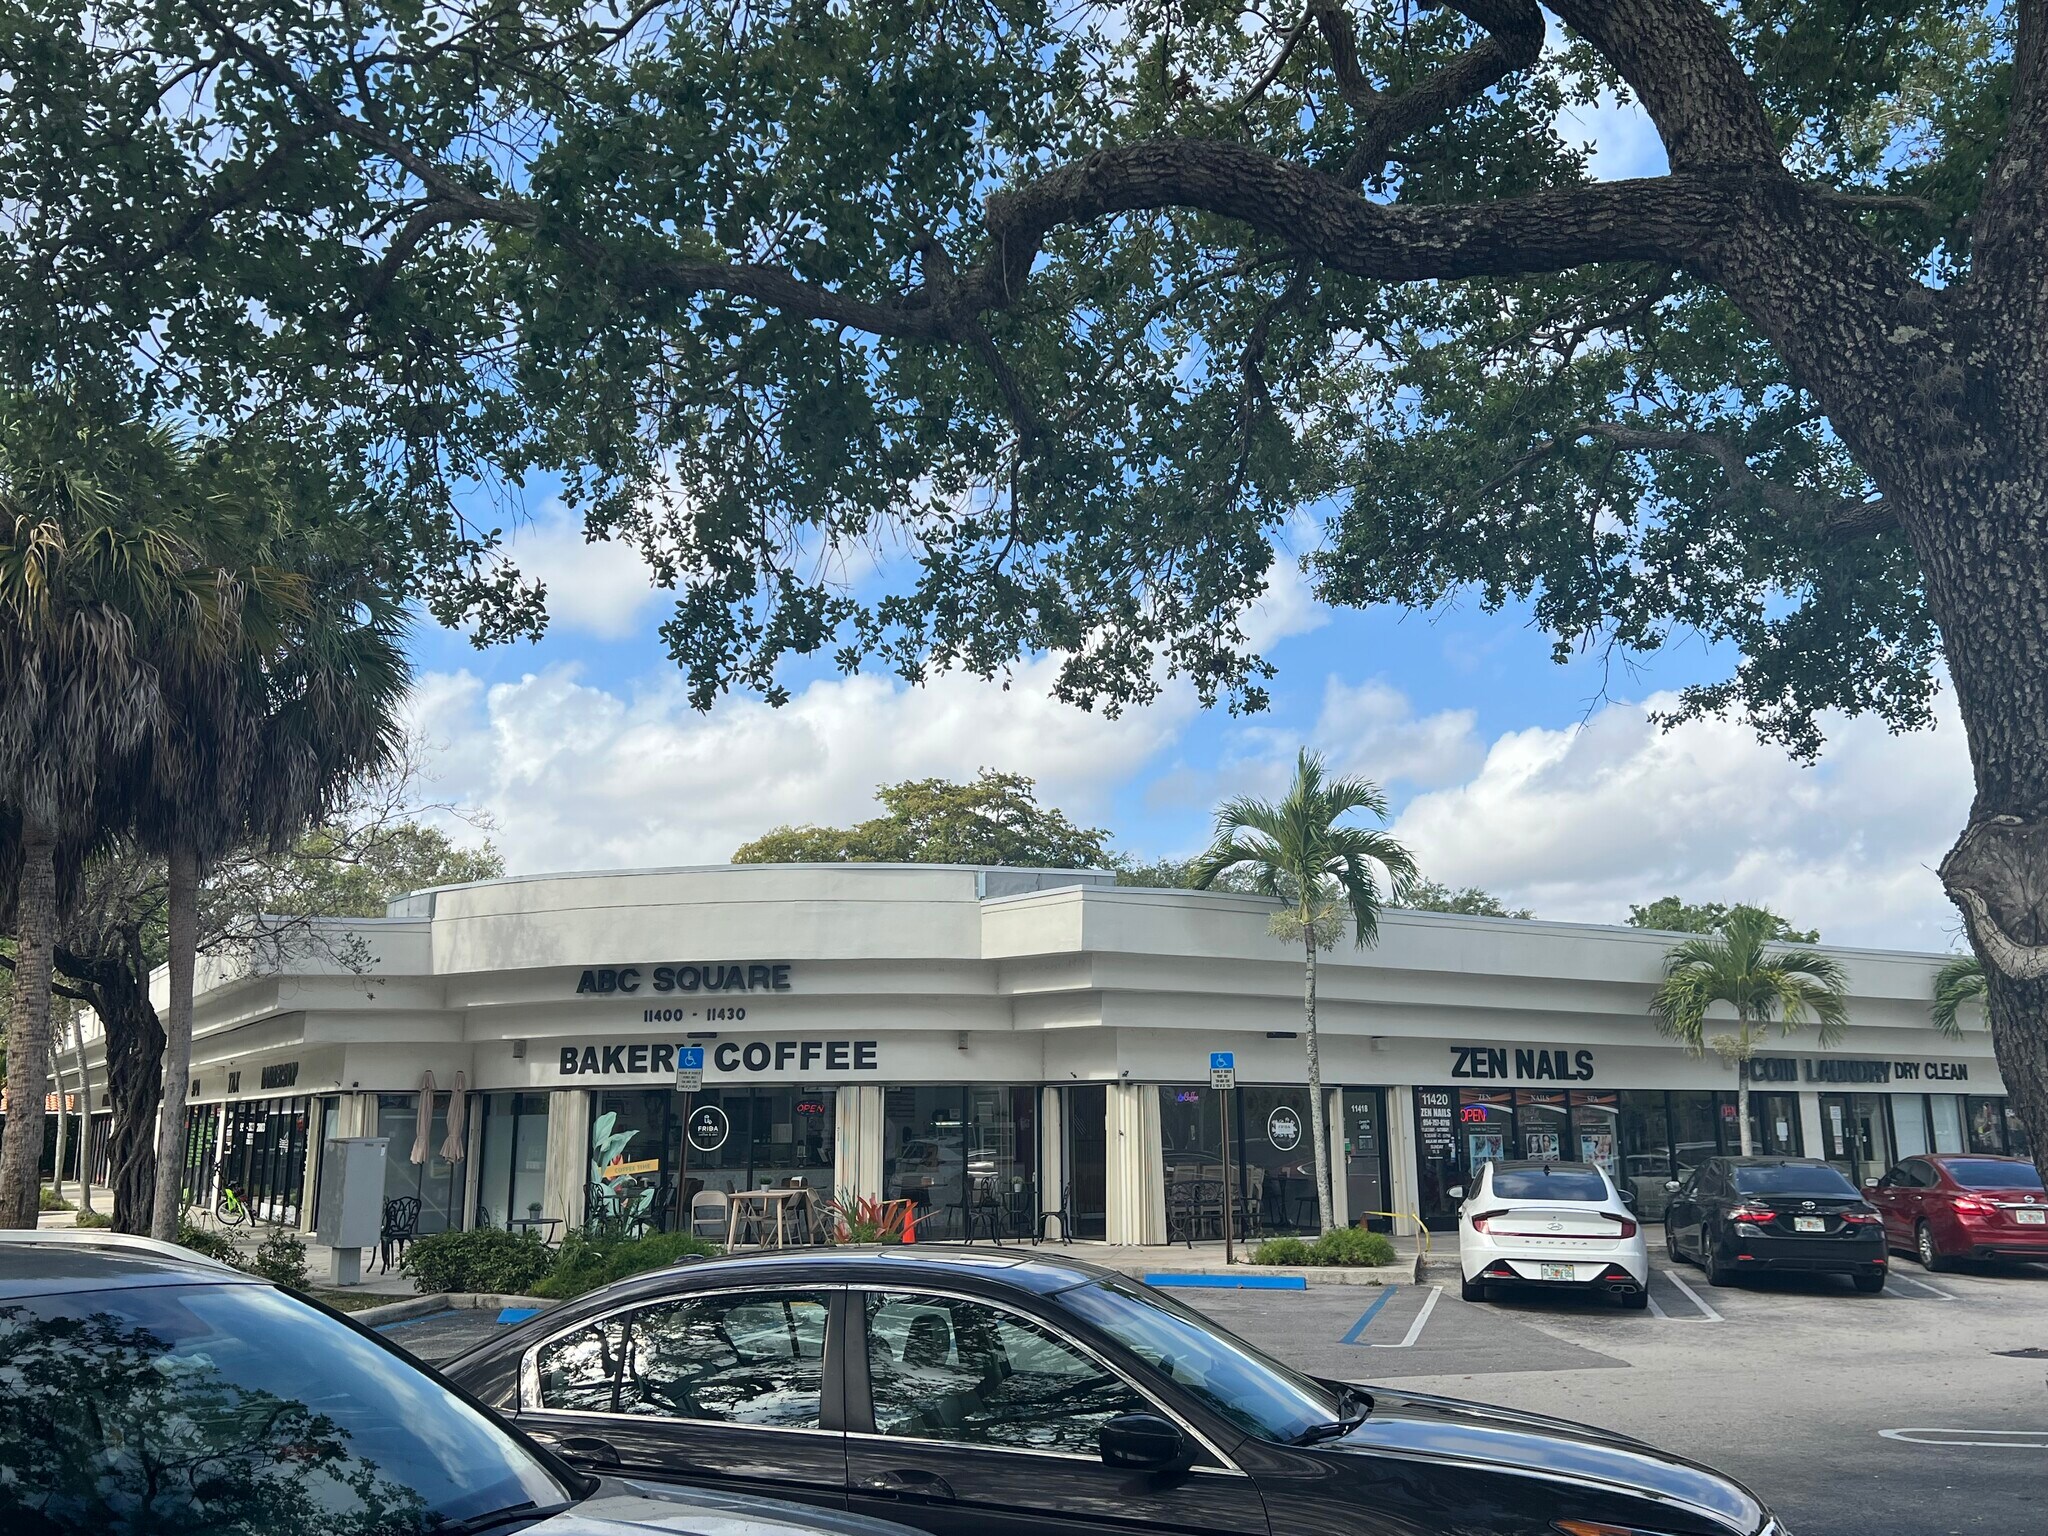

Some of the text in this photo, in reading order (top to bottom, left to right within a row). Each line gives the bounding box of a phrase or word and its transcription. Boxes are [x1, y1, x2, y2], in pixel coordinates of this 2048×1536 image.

[576, 965, 791, 994] ABC SQUARE
[643, 1008, 683, 1022] 11400
[706, 1007, 746, 1021] 11430
[559, 1041, 878, 1075] BAKER COFFEE
[1450, 1046, 1594, 1081] ZEN NAILS
[1750, 1057, 1968, 1083] COIN LAUNDRY DRY CLEAN
[227, 1071, 242, 1094] TAX
[1421, 1093, 1449, 1106] 11420
[1478, 1093, 1491, 1101] ZEN
[1530, 1094, 1550, 1102] NAILS
[1587, 1095, 1599, 1103] SPA
[796, 1103, 825, 1113] OPEN
[1420, 1107, 1452, 1118] ZEN NAILS
[1460, 1109, 1486, 1122] OPEN
